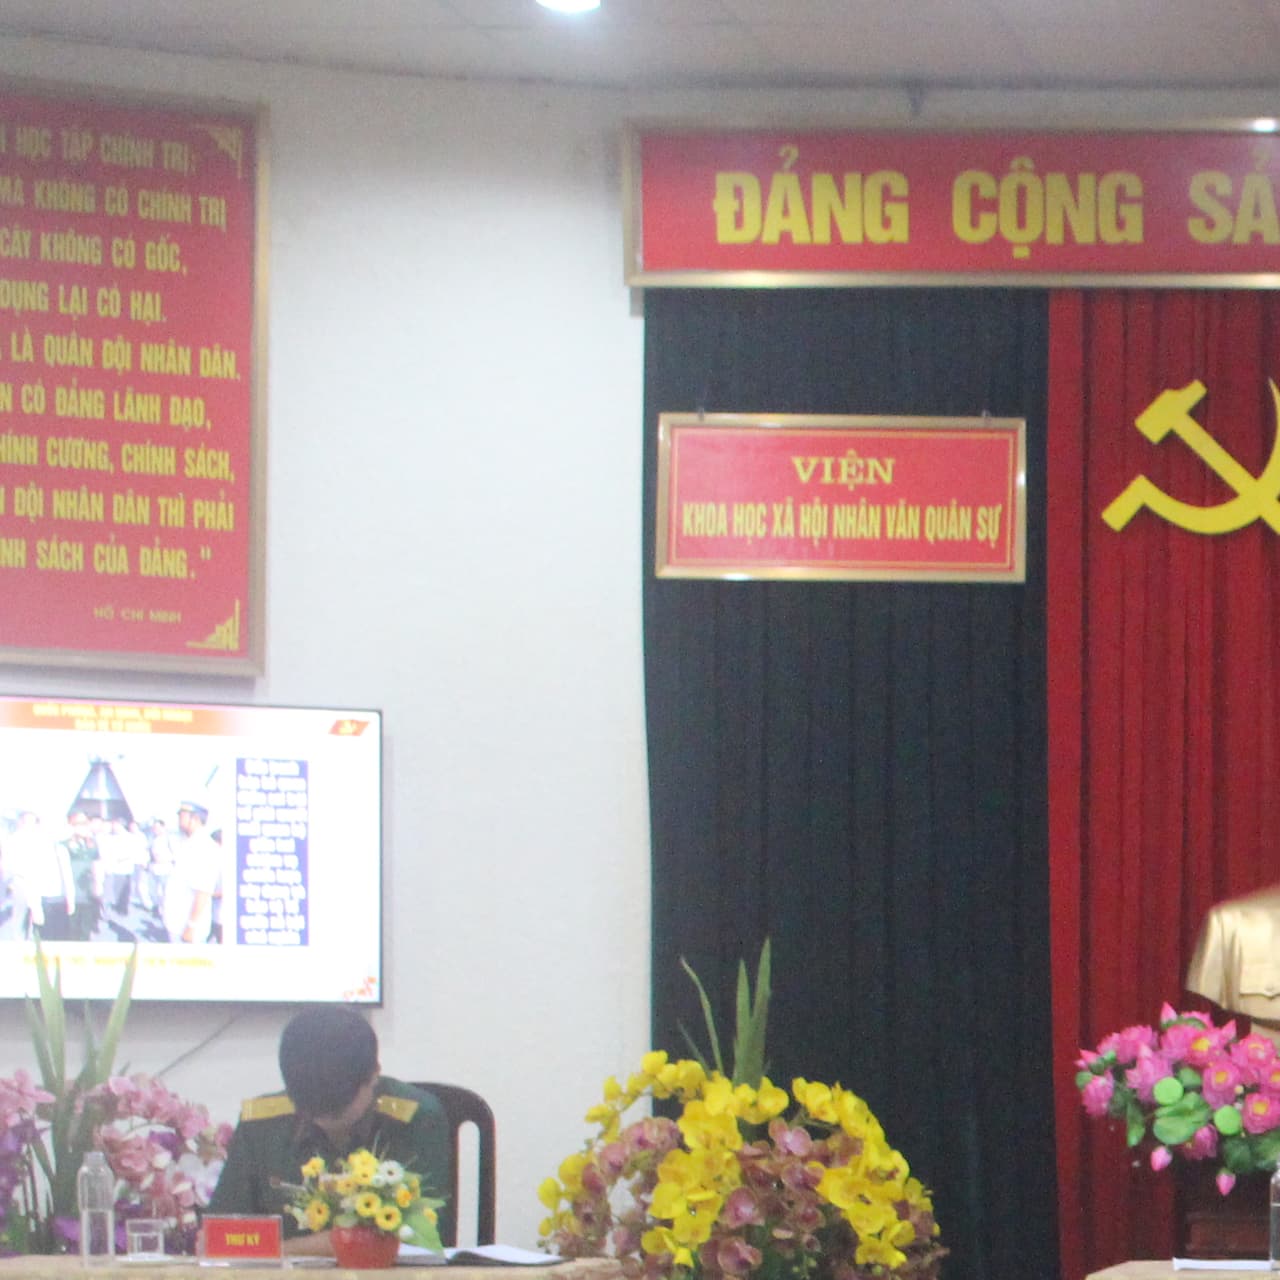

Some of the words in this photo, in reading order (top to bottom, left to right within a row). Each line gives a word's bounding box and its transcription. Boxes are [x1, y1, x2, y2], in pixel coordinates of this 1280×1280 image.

[34, 177, 95, 213] KHÔNG
[105, 183, 128, 216] CÓ
[138, 186, 192, 224] CHÍNH
[199, 195, 227, 232] TRỊ
[713, 145, 909, 247] ĐẢNG
[951, 157, 1143, 259] CỘNG
[0, 224, 32, 255] CÂY
[40, 228, 102, 264] KHÔNG
[111, 233, 136, 269] CÓ
[145, 234, 187, 279] GỐC,
[0, 280, 49, 317] DỤNG
[59, 284, 88, 320] LẠI
[96, 282, 121, 317] CÓ
[10, 325, 34, 362] LÀ
[43, 329, 93, 369] QUÂN
[102, 334, 131, 376] ĐỘI
[141, 338, 191, 375] NHÂN
[200, 342, 241, 381] DÂN.
[21, 379, 45, 415] CÓ
[56, 378, 105, 419] ĐẢNG
[114, 387, 161, 424] LÃNH
[170, 396, 211, 431] ĐẠO,
[0, 427, 38, 464] HÍNH
[46, 437, 114, 475] CƯƠNG,
[122, 441, 176, 475] CHÍNH
[185, 442, 235, 483] SÁCH,
[791, 449, 895, 491] VIỆN
[15, 481, 44, 522] ĐỘI
[53, 486, 104, 522] NHÂN
[113, 490, 149, 525] DÂN
[158, 492, 185, 529] THÌ
[193, 490, 234, 531] PHẢI
[683, 502, 728, 538] KHOA
[733, 503, 767, 544] HỌC
[772, 497, 794, 538] XÃ
[799, 497, 828, 547] HỘI
[833, 497, 880, 539] NHÂN
[886, 498, 921, 540] VĂN
[925, 498, 971, 544] QUÂN
[976, 504, 1002, 548] SỰ
[37, 534, 84, 571] SÁCH
[94, 534, 129, 574] CỦA
